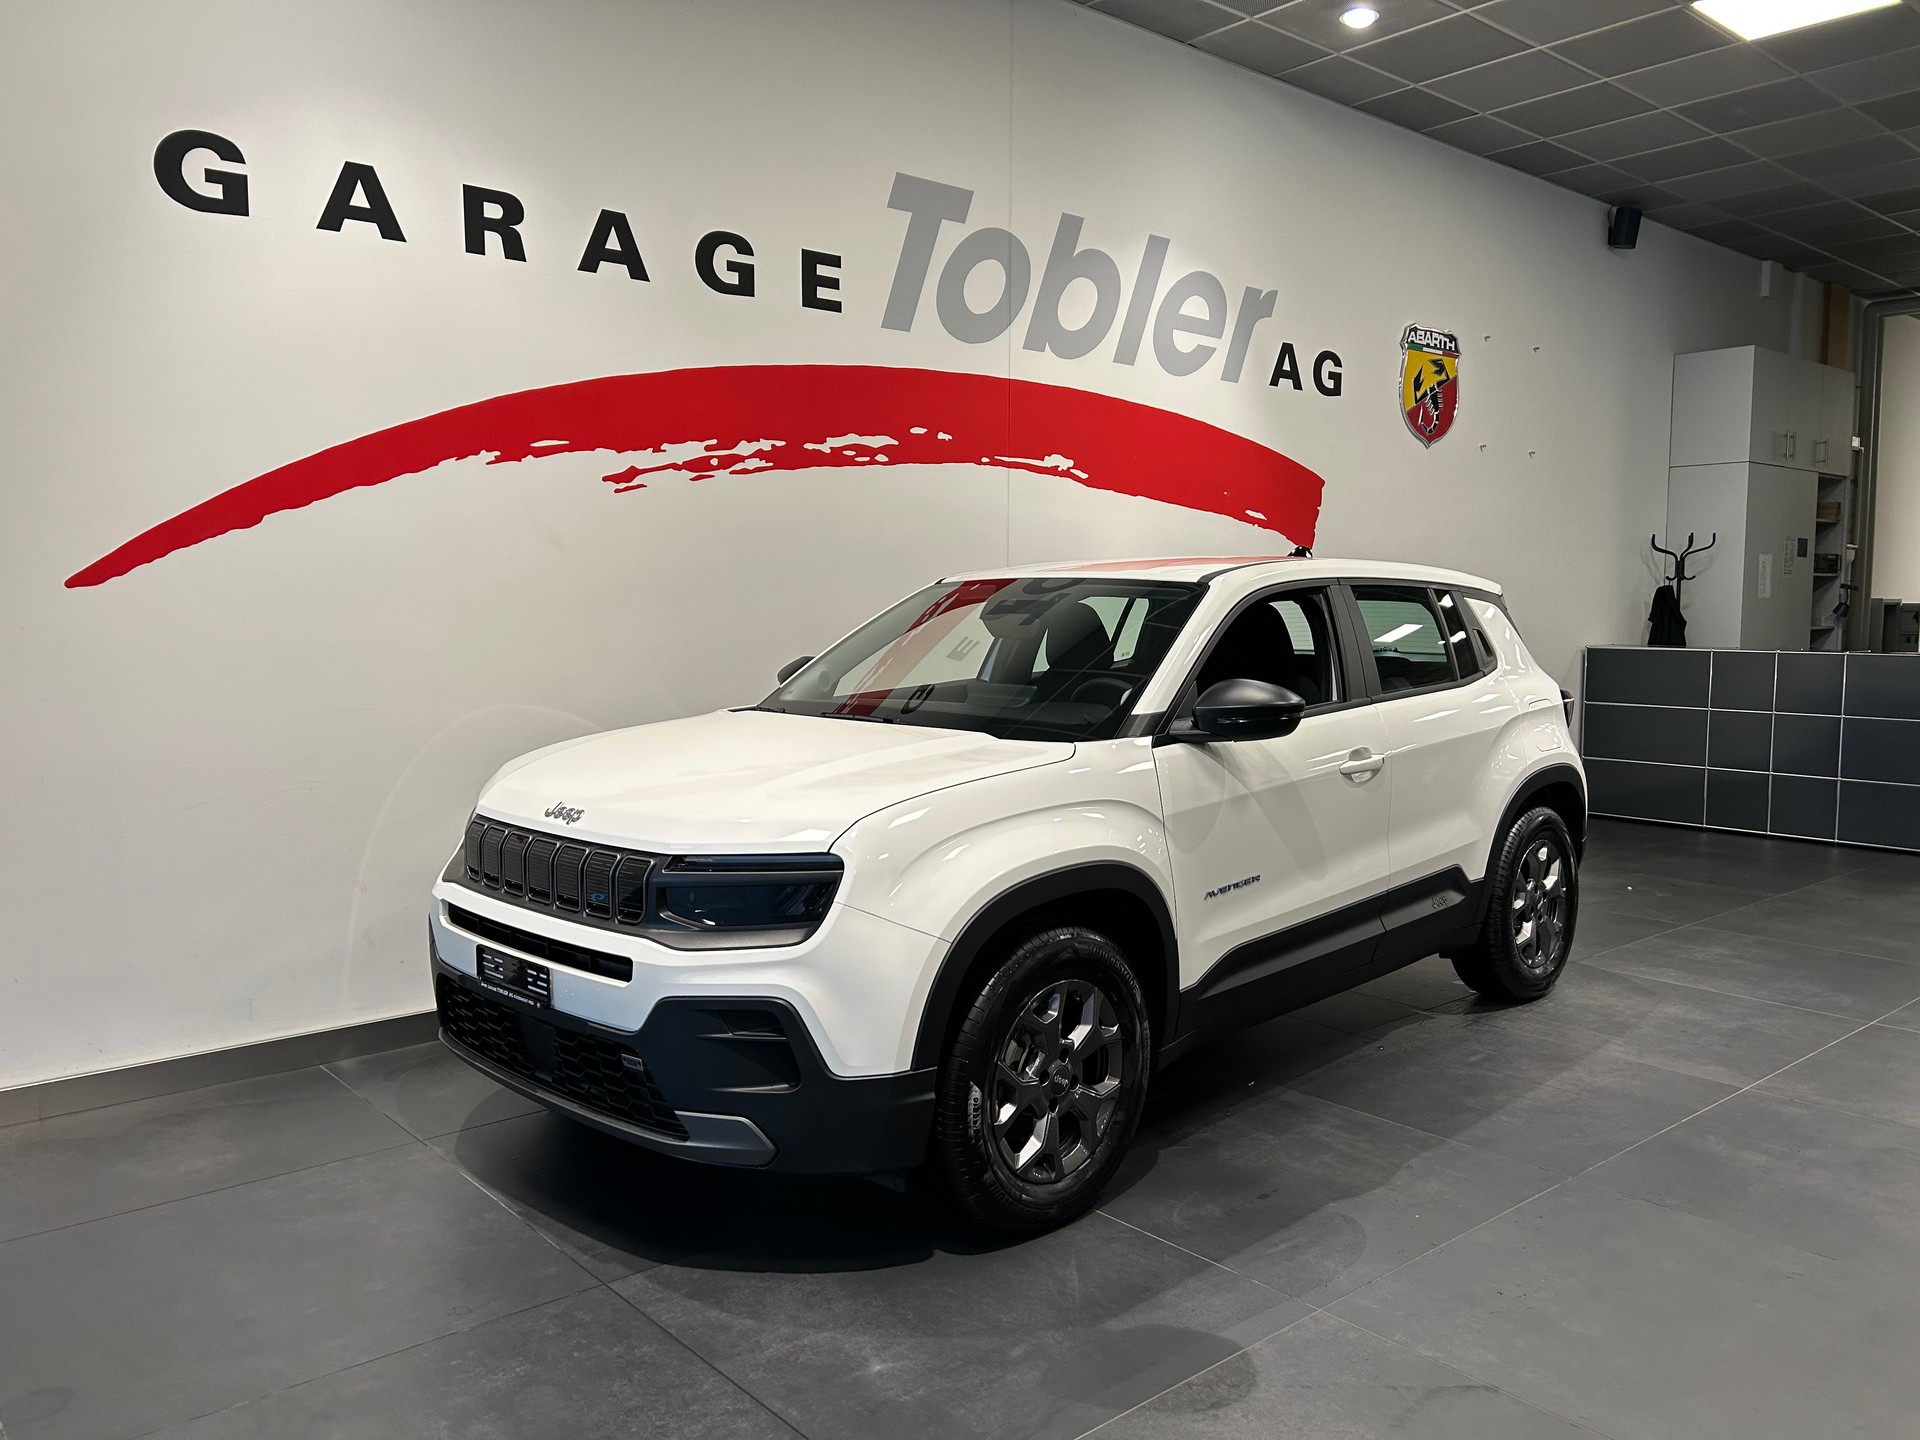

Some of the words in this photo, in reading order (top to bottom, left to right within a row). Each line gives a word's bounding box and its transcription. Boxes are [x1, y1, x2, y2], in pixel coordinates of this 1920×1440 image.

[153, 129, 844, 313] GARAGE
[880, 171, 1278, 383] Tobler
[1268, 341, 1344, 397] AG
[1407, 329, 1456, 351] ABARTH
[544, 801, 585, 825] Jeep
[1203, 874, 1261, 901] AVENGER
[1431, 895, 1449, 909] Jeep
